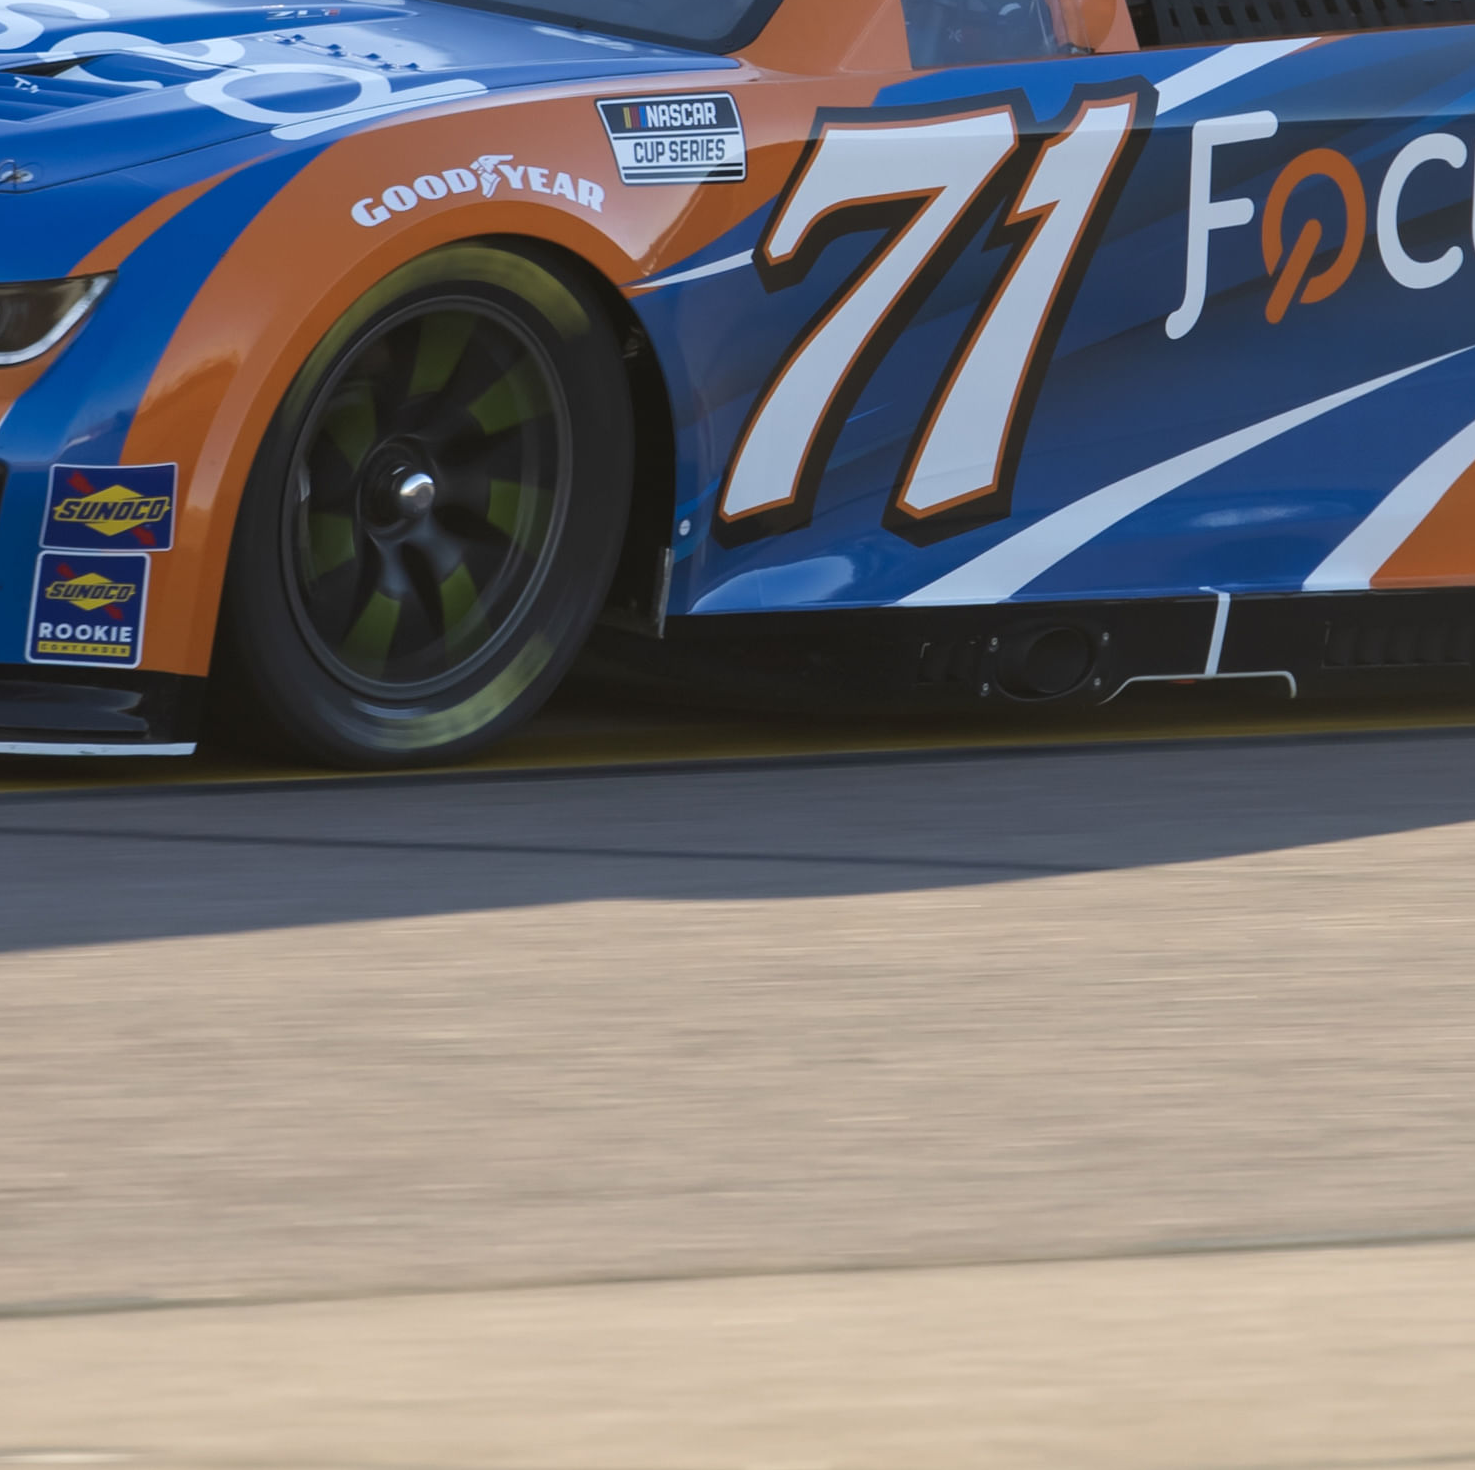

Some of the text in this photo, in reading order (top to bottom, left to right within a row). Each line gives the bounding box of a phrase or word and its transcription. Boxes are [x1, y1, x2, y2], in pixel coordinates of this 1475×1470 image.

[644, 101, 718, 129] NASCAR
[632, 137, 726, 164] CUP SERIES
[350, 157, 606, 228] GOODYEAR
[718, 91, 1140, 524] 71
[58, 499, 167, 521] SUNOCO
[49, 583, 133, 600] SUNOCO
[38, 621, 134, 643] ROOKIE
